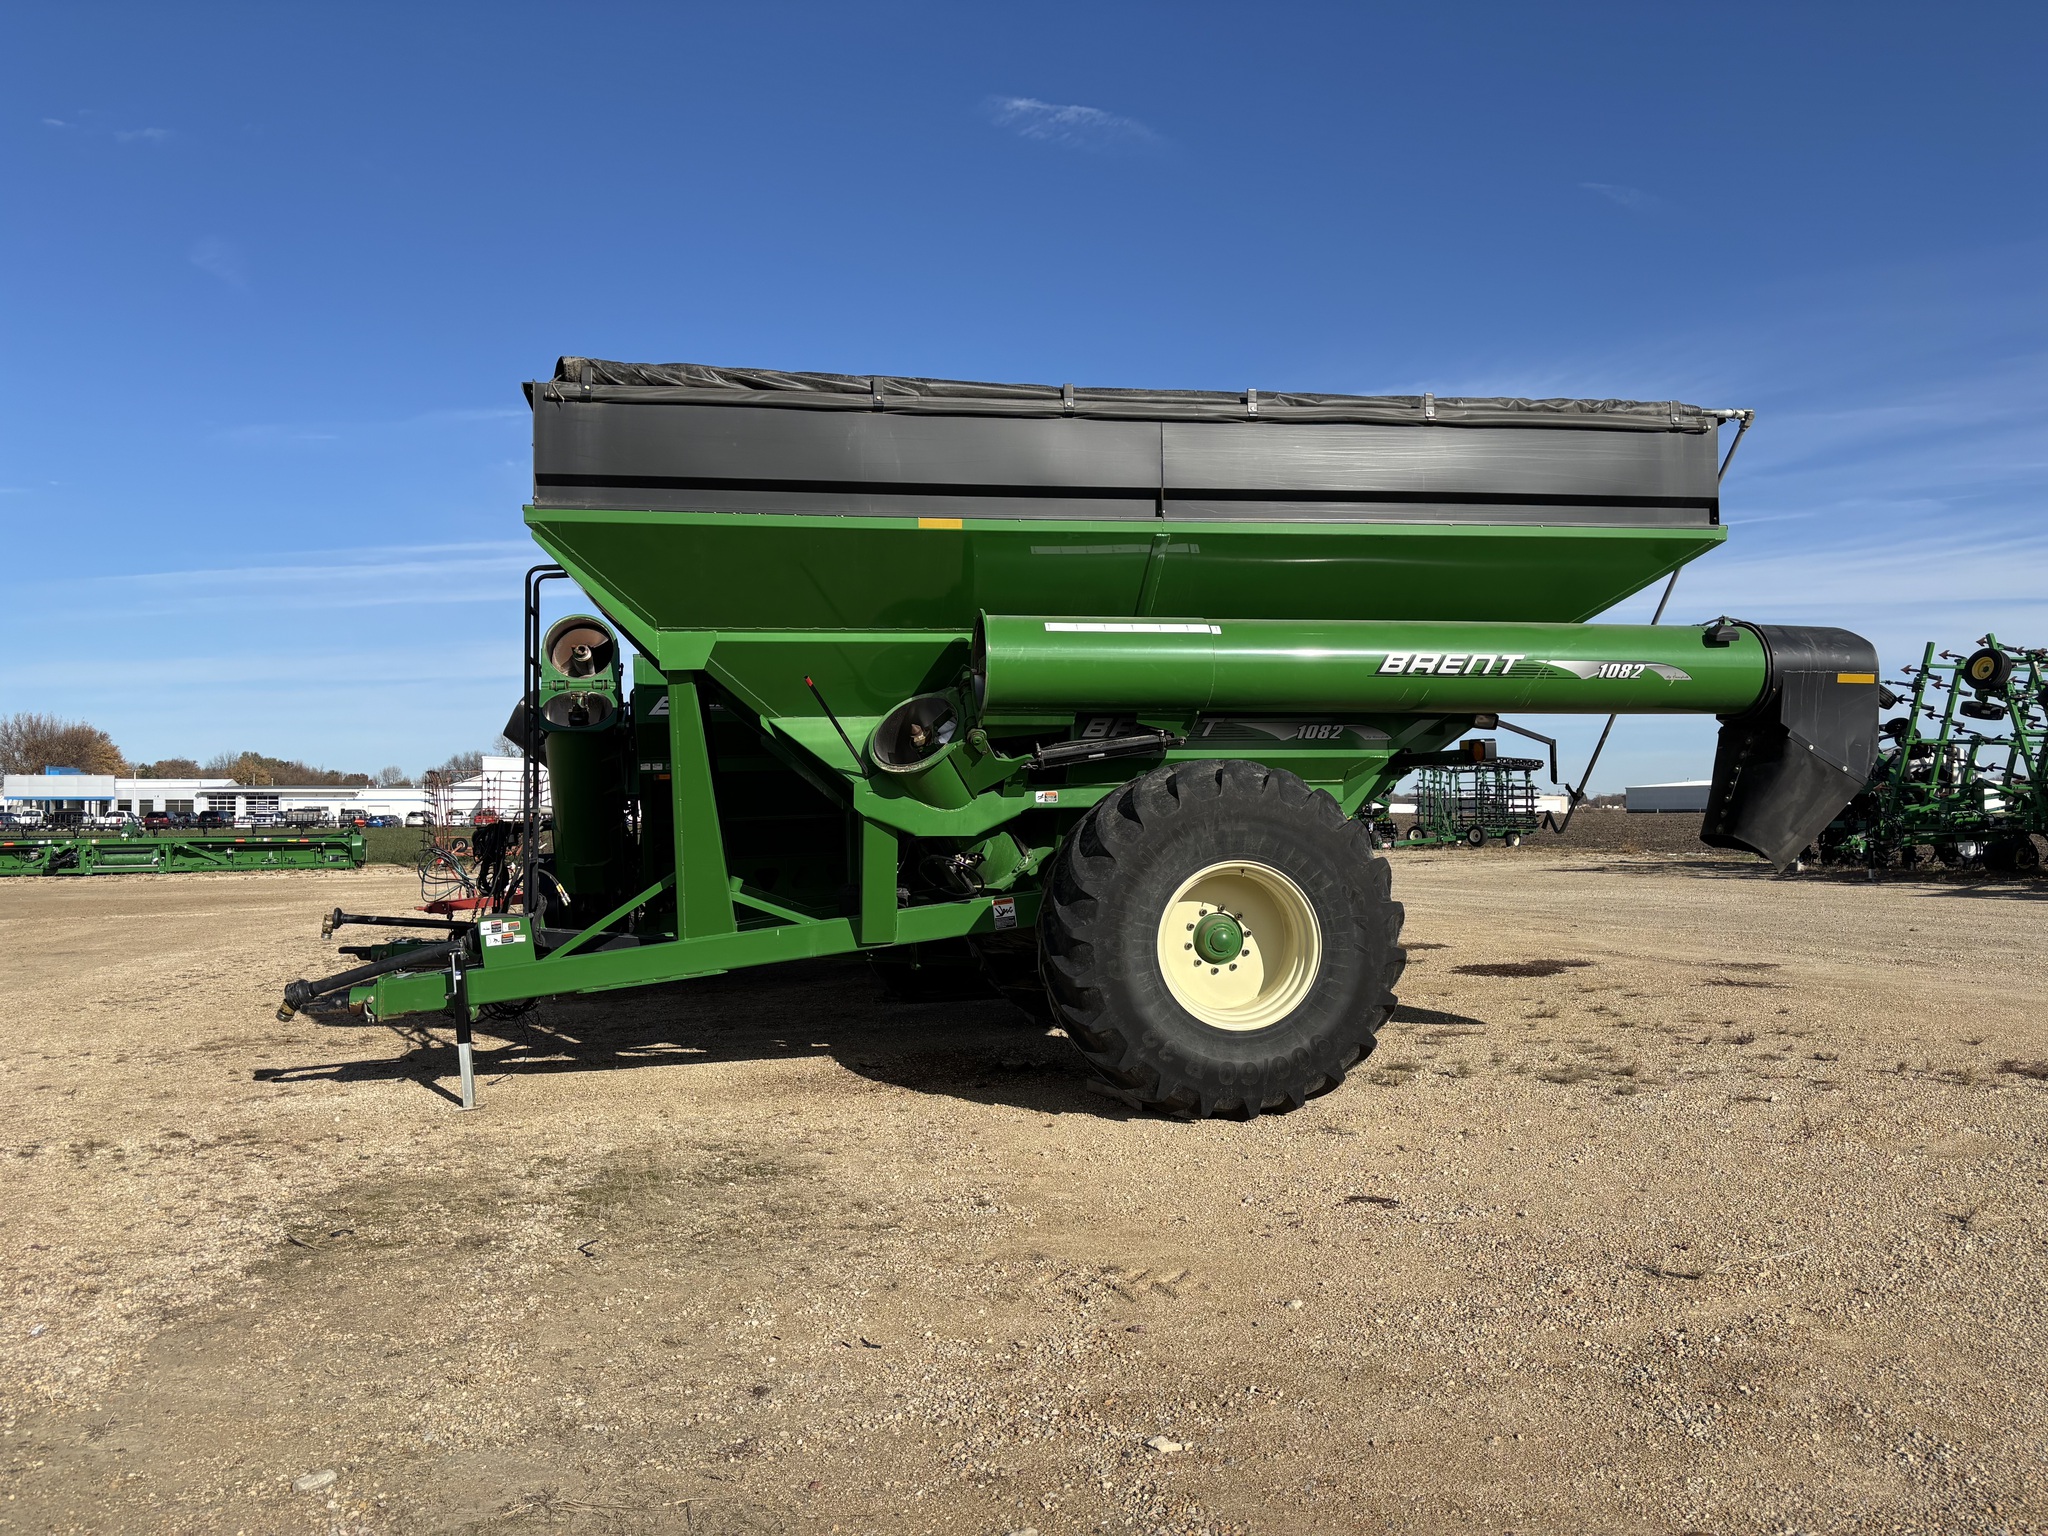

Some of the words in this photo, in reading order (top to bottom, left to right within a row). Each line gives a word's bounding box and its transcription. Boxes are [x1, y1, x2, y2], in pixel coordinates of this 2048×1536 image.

[1378, 653, 1526, 676] BRENT
[1597, 662, 1646, 680] 1082
[1296, 724, 1345, 740] 1082
